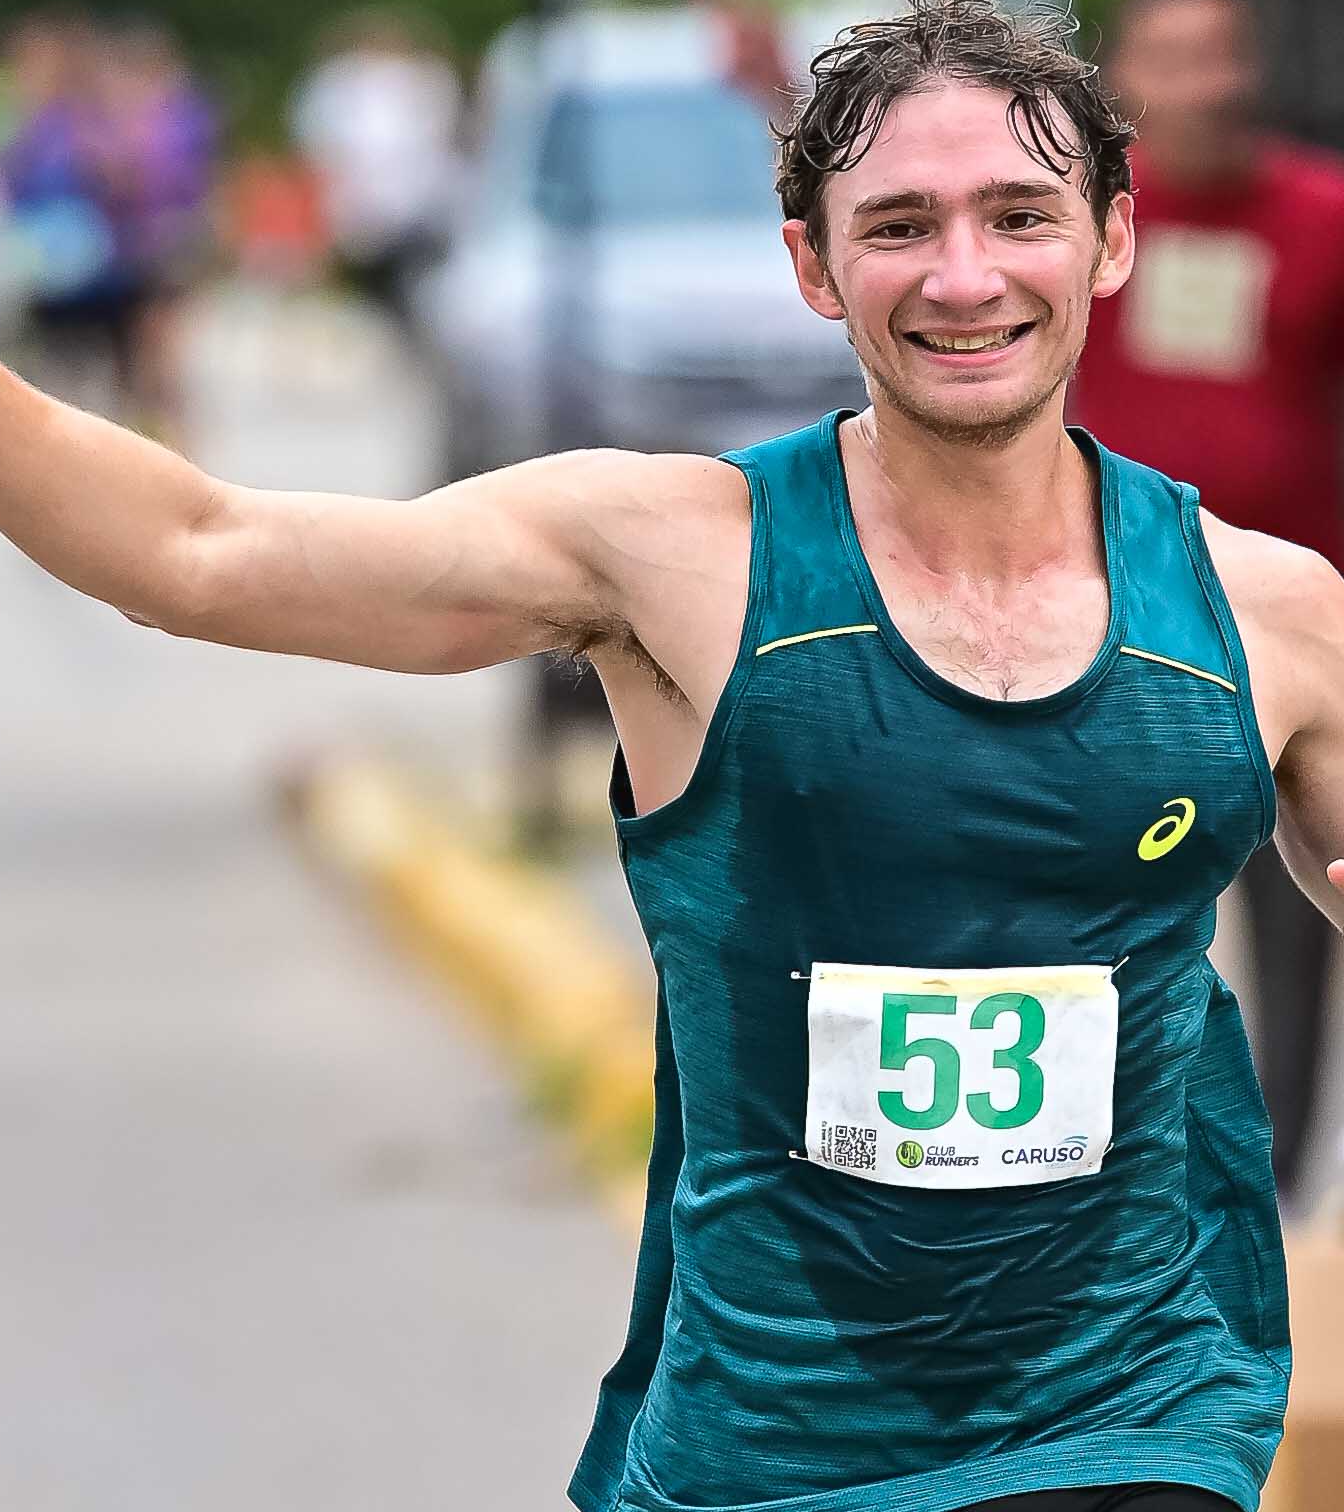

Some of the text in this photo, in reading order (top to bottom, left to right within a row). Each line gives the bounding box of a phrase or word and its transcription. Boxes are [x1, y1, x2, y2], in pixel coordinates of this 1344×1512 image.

[877, 992, 1045, 1130] 53
[927, 1145, 956, 1156] CLUB
[1001, 1147, 1084, 1165] CARUSO
